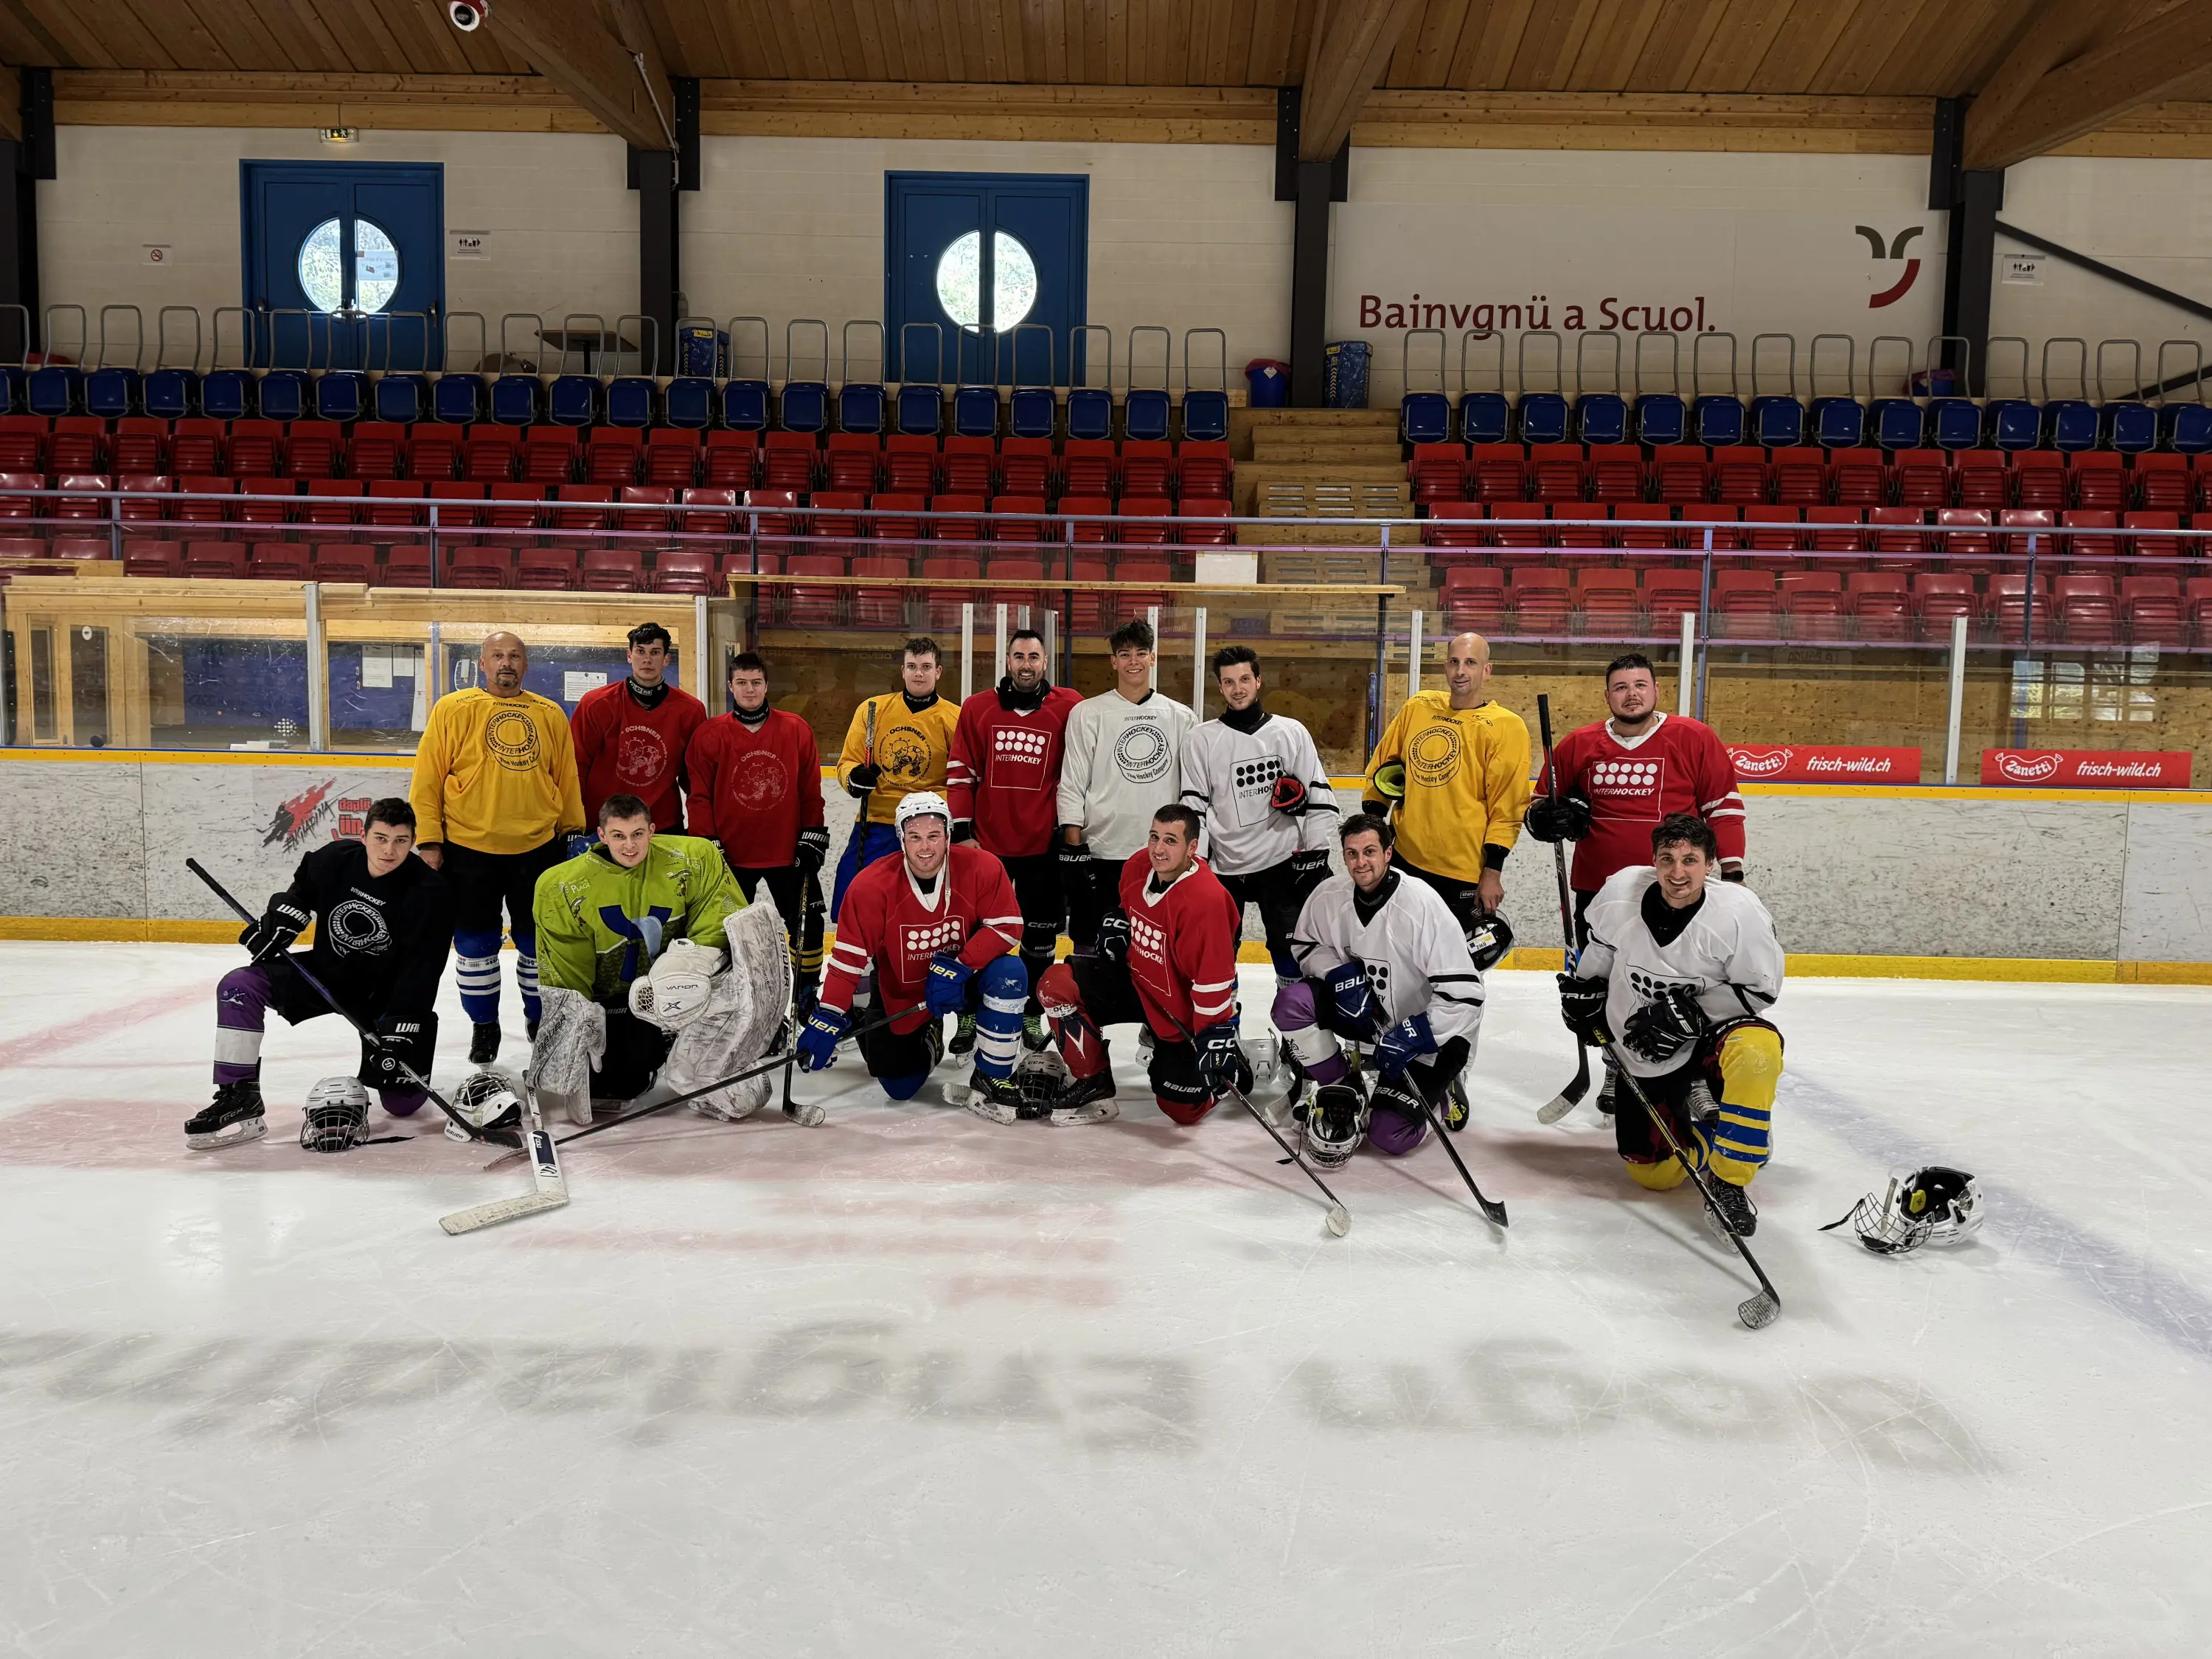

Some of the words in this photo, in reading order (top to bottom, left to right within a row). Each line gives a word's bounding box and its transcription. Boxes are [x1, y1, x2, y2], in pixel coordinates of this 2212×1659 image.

[1360, 293, 1551, 341] Bainvgnü
[1564, 305, 1586, 330] a
[1599, 297, 1716, 332] Scuol.
[625, 725, 661, 740] OCHSNER
[889, 726, 927, 742] OCHSNER
[1117, 726, 1155, 752] INTERHOCKEY
[1413, 727, 1455, 747] INTERHOCKEY
[740, 750, 776, 762] OCHSNER
[995, 754, 1042, 765] INTERHOCKEY
[1127, 742, 1165, 768] INTERHOCKEY
[1416, 748, 1457, 770] INTERHOCKEY
[1735, 755, 1783, 771] Zanetti
[1806, 756, 1891, 773] frisch-wild.ch
[2006, 760, 2053, 776] Zanetti
[2076, 761, 2162, 777] frisch-wild.ch
[1239, 782, 1276, 799] INTERHOCK
[1593, 787, 1655, 796] INTERHOCKEY
[1059, 854, 1091, 862] BAUER
[350, 886, 386, 906] INTERHOCKEY
[1560, 991, 1607, 1000] TRUE
[538, 1015, 567, 1052] BAUER
[1163, 1080, 1203, 1093] BAUER
[1374, 1086, 1419, 1109] BAUER
[445, 1128, 464, 1139] BAUER
